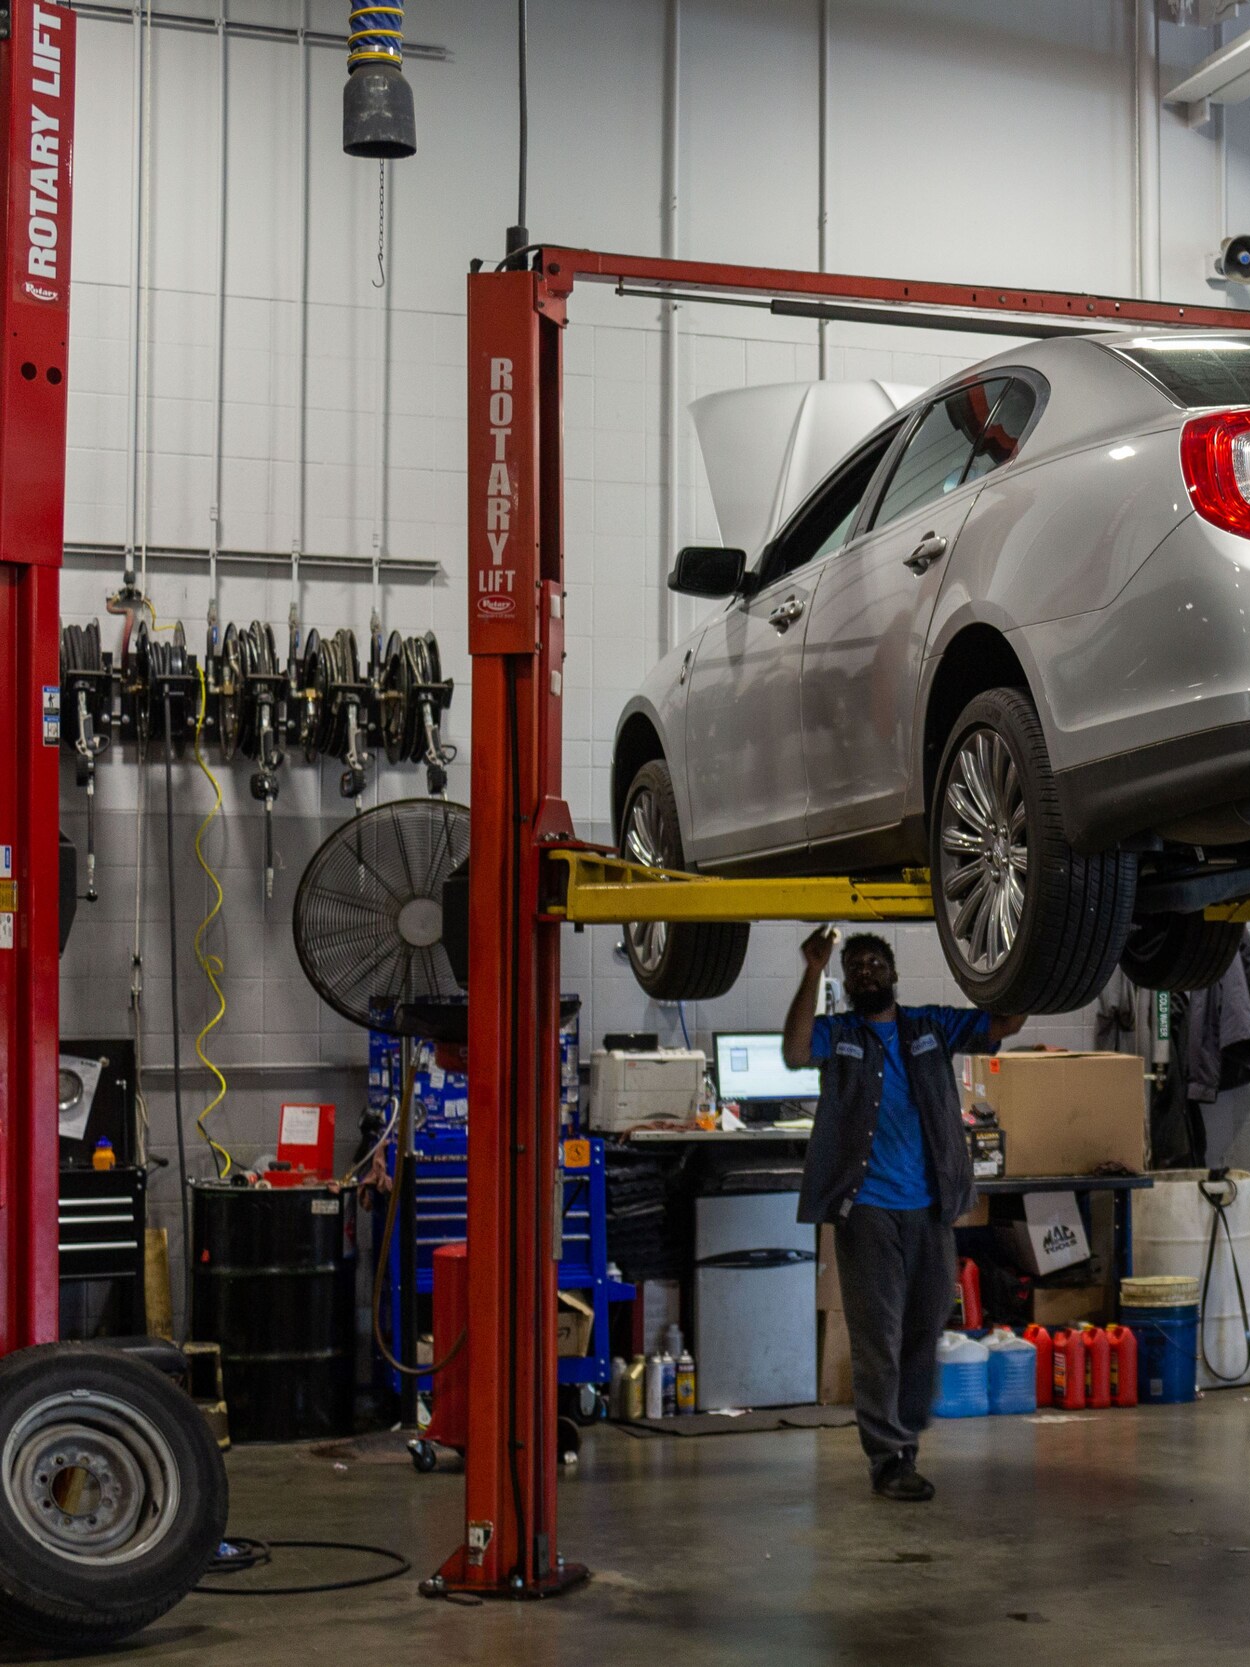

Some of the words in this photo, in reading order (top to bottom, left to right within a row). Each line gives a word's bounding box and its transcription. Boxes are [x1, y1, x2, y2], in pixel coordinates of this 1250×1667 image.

[32, 3, 62, 98] LIFT
[28, 104, 60, 279] ROTARY
[487, 357, 513, 566] ROTARY
[479, 570, 515, 593] LIFT
[1159, 993, 1168, 1013] COLD
[1160, 1013, 1168, 1037] WATER
[1043, 1225, 1076, 1249] MAC
